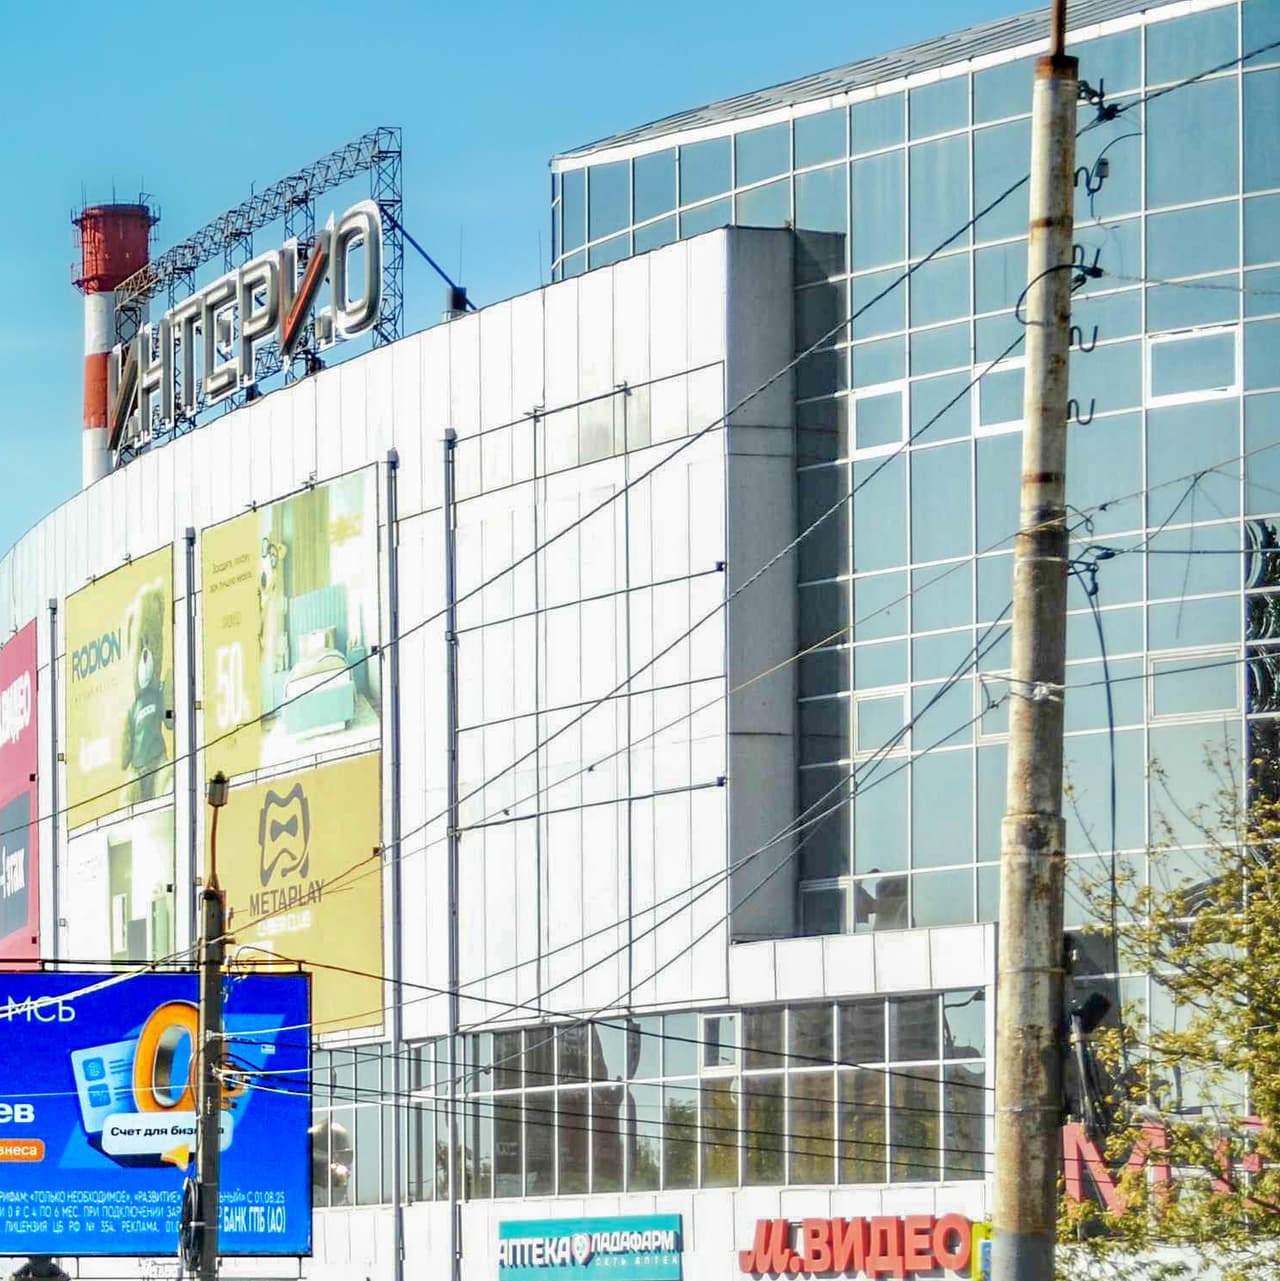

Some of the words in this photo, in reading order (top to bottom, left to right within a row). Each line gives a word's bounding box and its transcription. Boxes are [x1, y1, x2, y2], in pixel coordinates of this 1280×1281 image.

[108, 199, 383, 466] ИНТЕРИО
[71, 628, 122, 683] RODION
[249, 879, 325, 917] METAPLAY
[7, 995, 76, 1023] МСБ
[111, 1126, 141, 1137] Счет
[144, 1126, 168, 1137] для
[5, 1219, 48, 1233] ЛИЦЕНЗИЯ
[68, 1220, 80, 1233] РФ
[40, 1205, 51, 1218] ПО
[83, 1205, 100, 1218] ПРИ
[102, 1205, 164, 1218] ПОДКЛЮЧЕНИИ
[498, 1237, 571, 1267] АПТЕКА
[590, 1229, 675, 1252] ЛАДАФАРМ
[634, 1255, 679, 1266] АПТЕК
[738, 1212, 974, 1279] М.ВИДЕО
